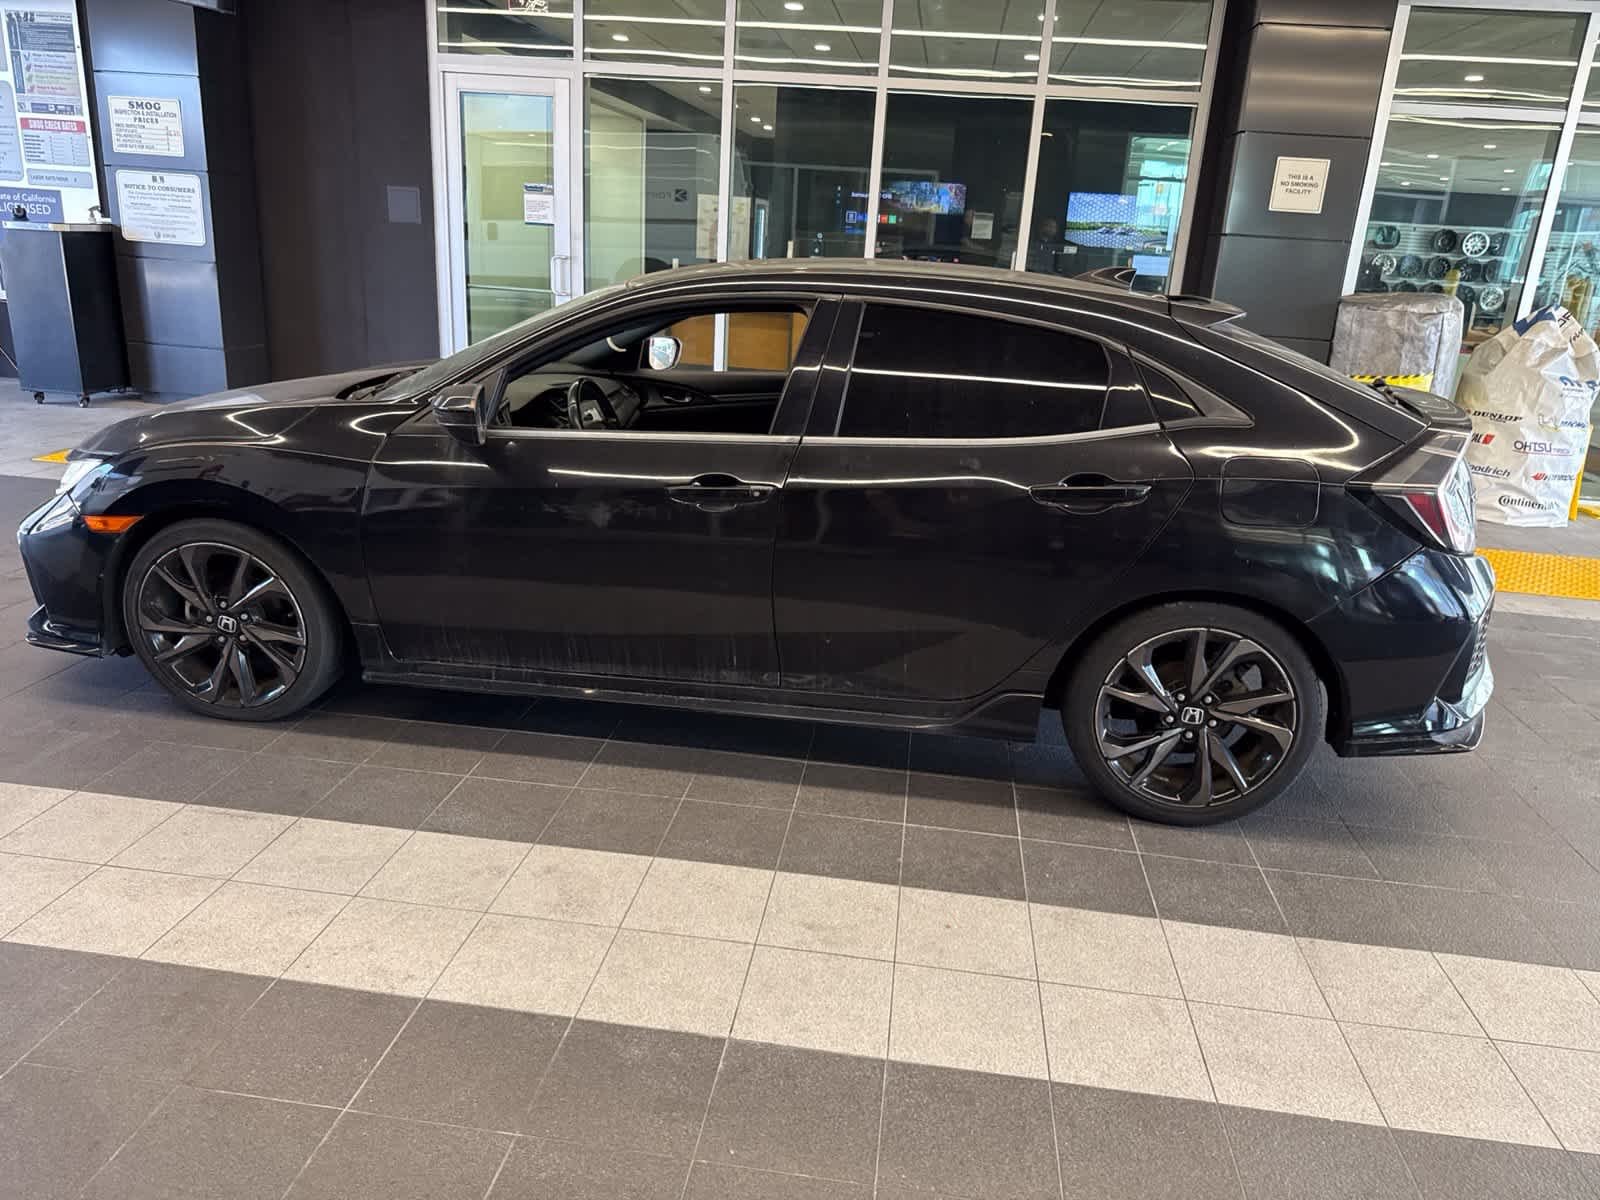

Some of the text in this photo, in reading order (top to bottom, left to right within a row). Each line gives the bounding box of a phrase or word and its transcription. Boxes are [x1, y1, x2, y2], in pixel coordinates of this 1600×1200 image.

[128, 101, 161, 111] SMOG
[1290, 181, 1319, 189] SMOKING
[12, 192, 21, 201] of
[21, 192, 57, 203] California
[1472, 410, 1523, 422] DUNLOP
[1513, 440, 1552, 453] OHTSU
[1468, 463, 1511, 478] oodrich
